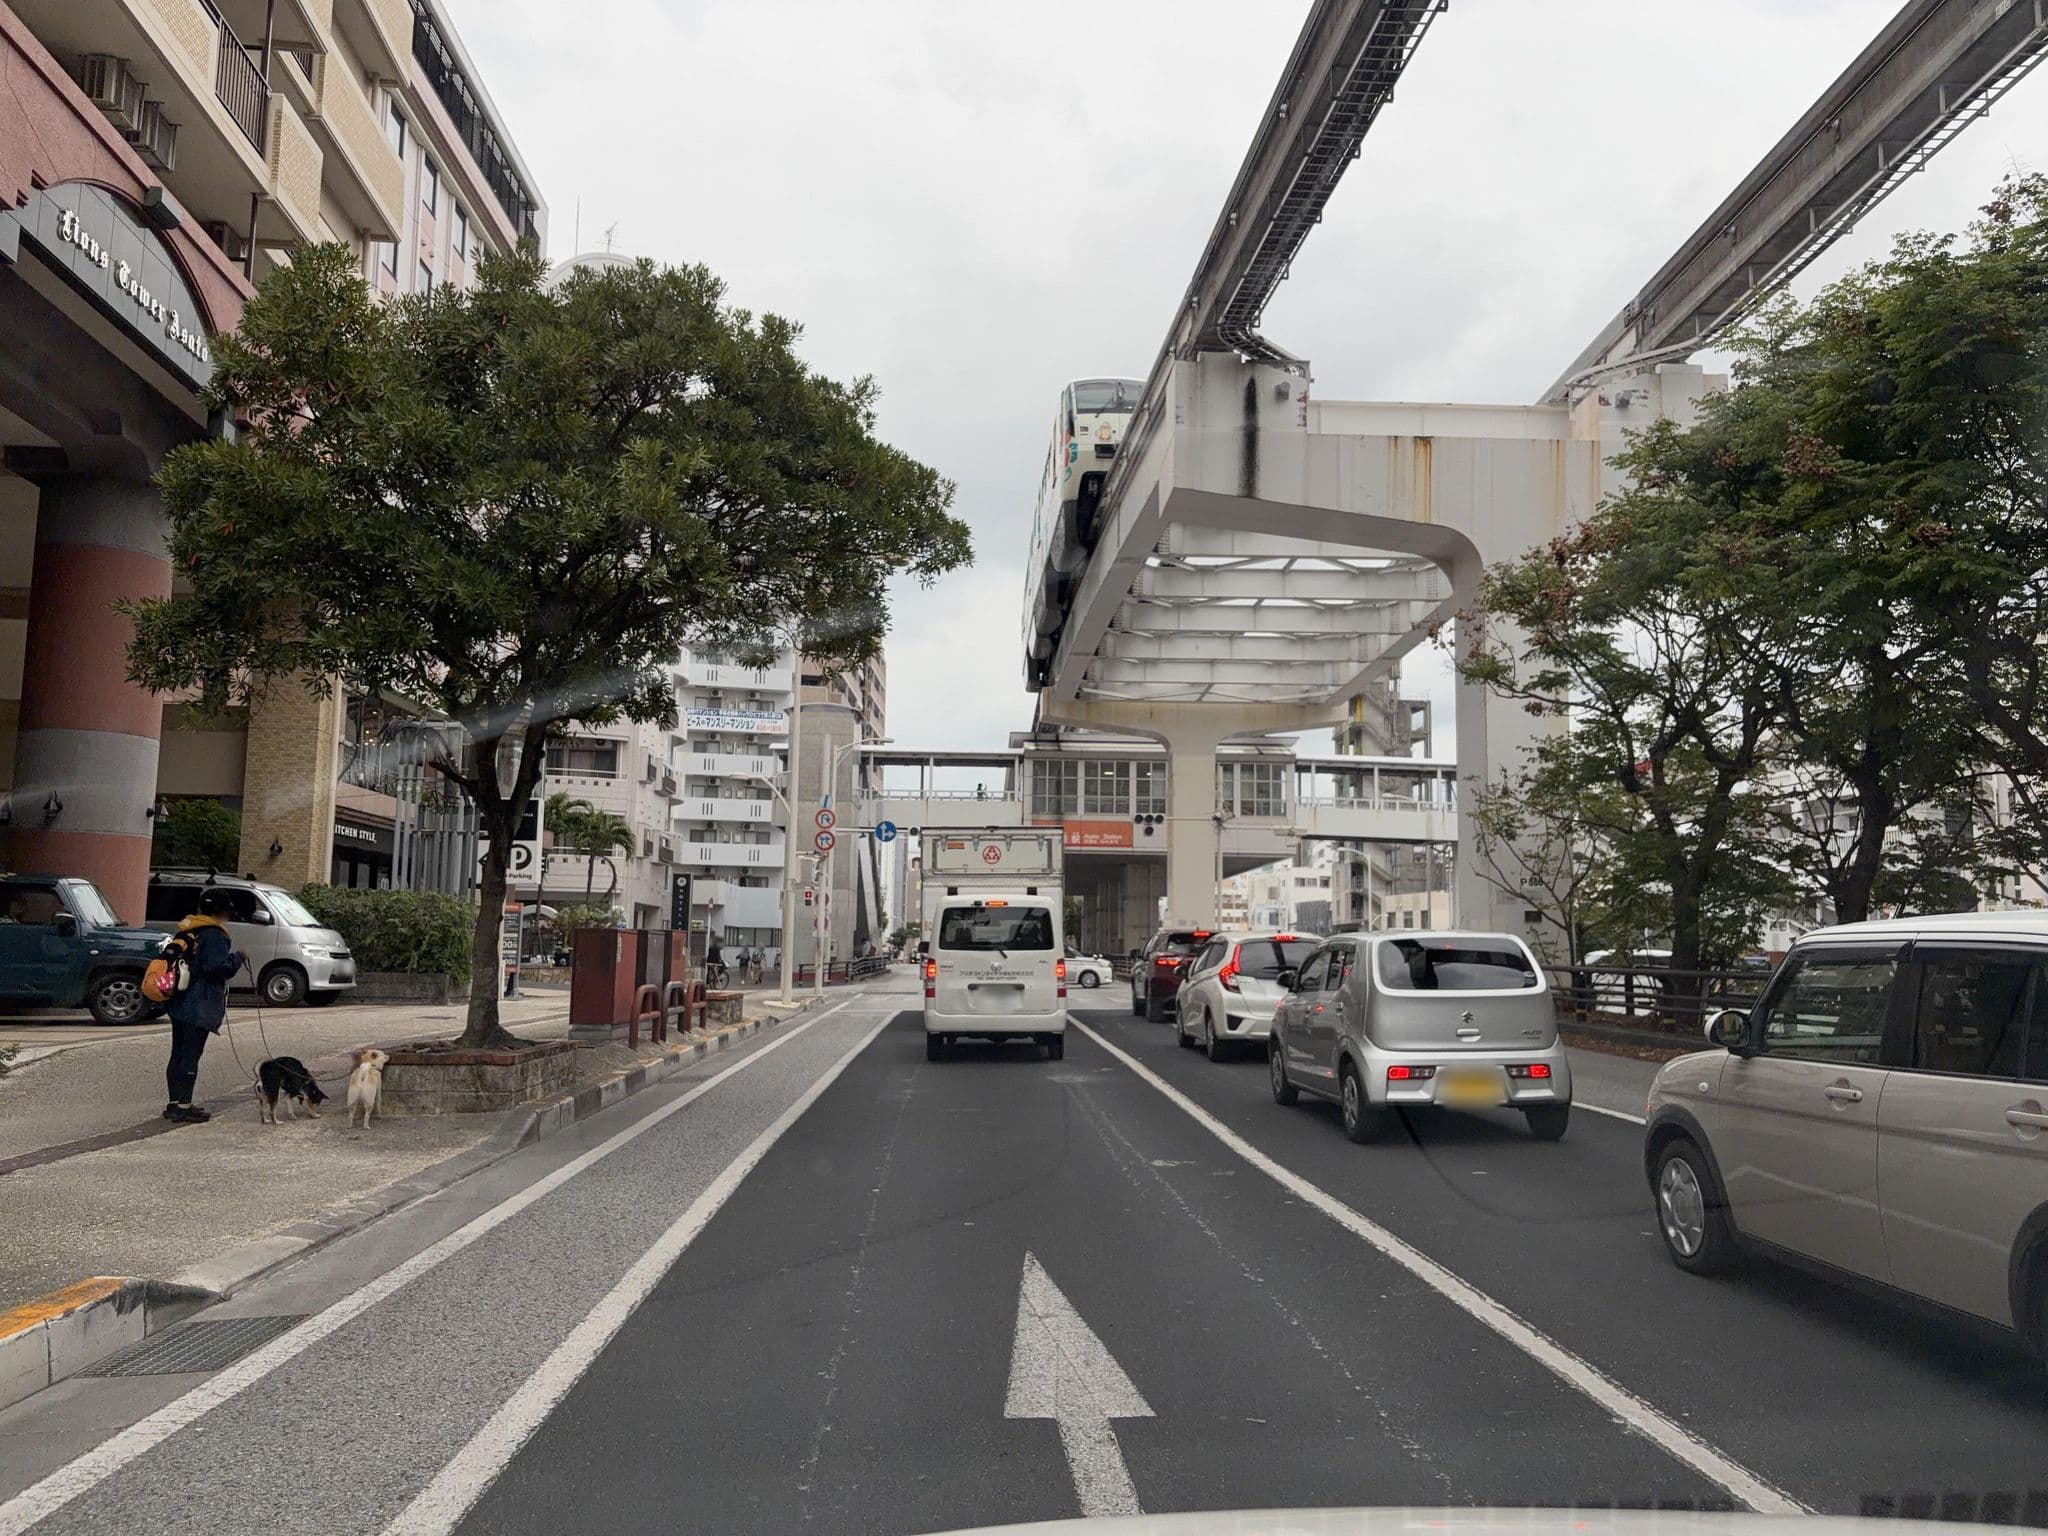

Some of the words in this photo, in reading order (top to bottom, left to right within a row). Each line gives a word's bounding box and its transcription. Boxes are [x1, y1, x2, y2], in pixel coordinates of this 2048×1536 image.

[116, 258, 167, 323] Tower
[168, 308, 209, 362] Asato
[334, 823, 359, 838] ITCHEN
